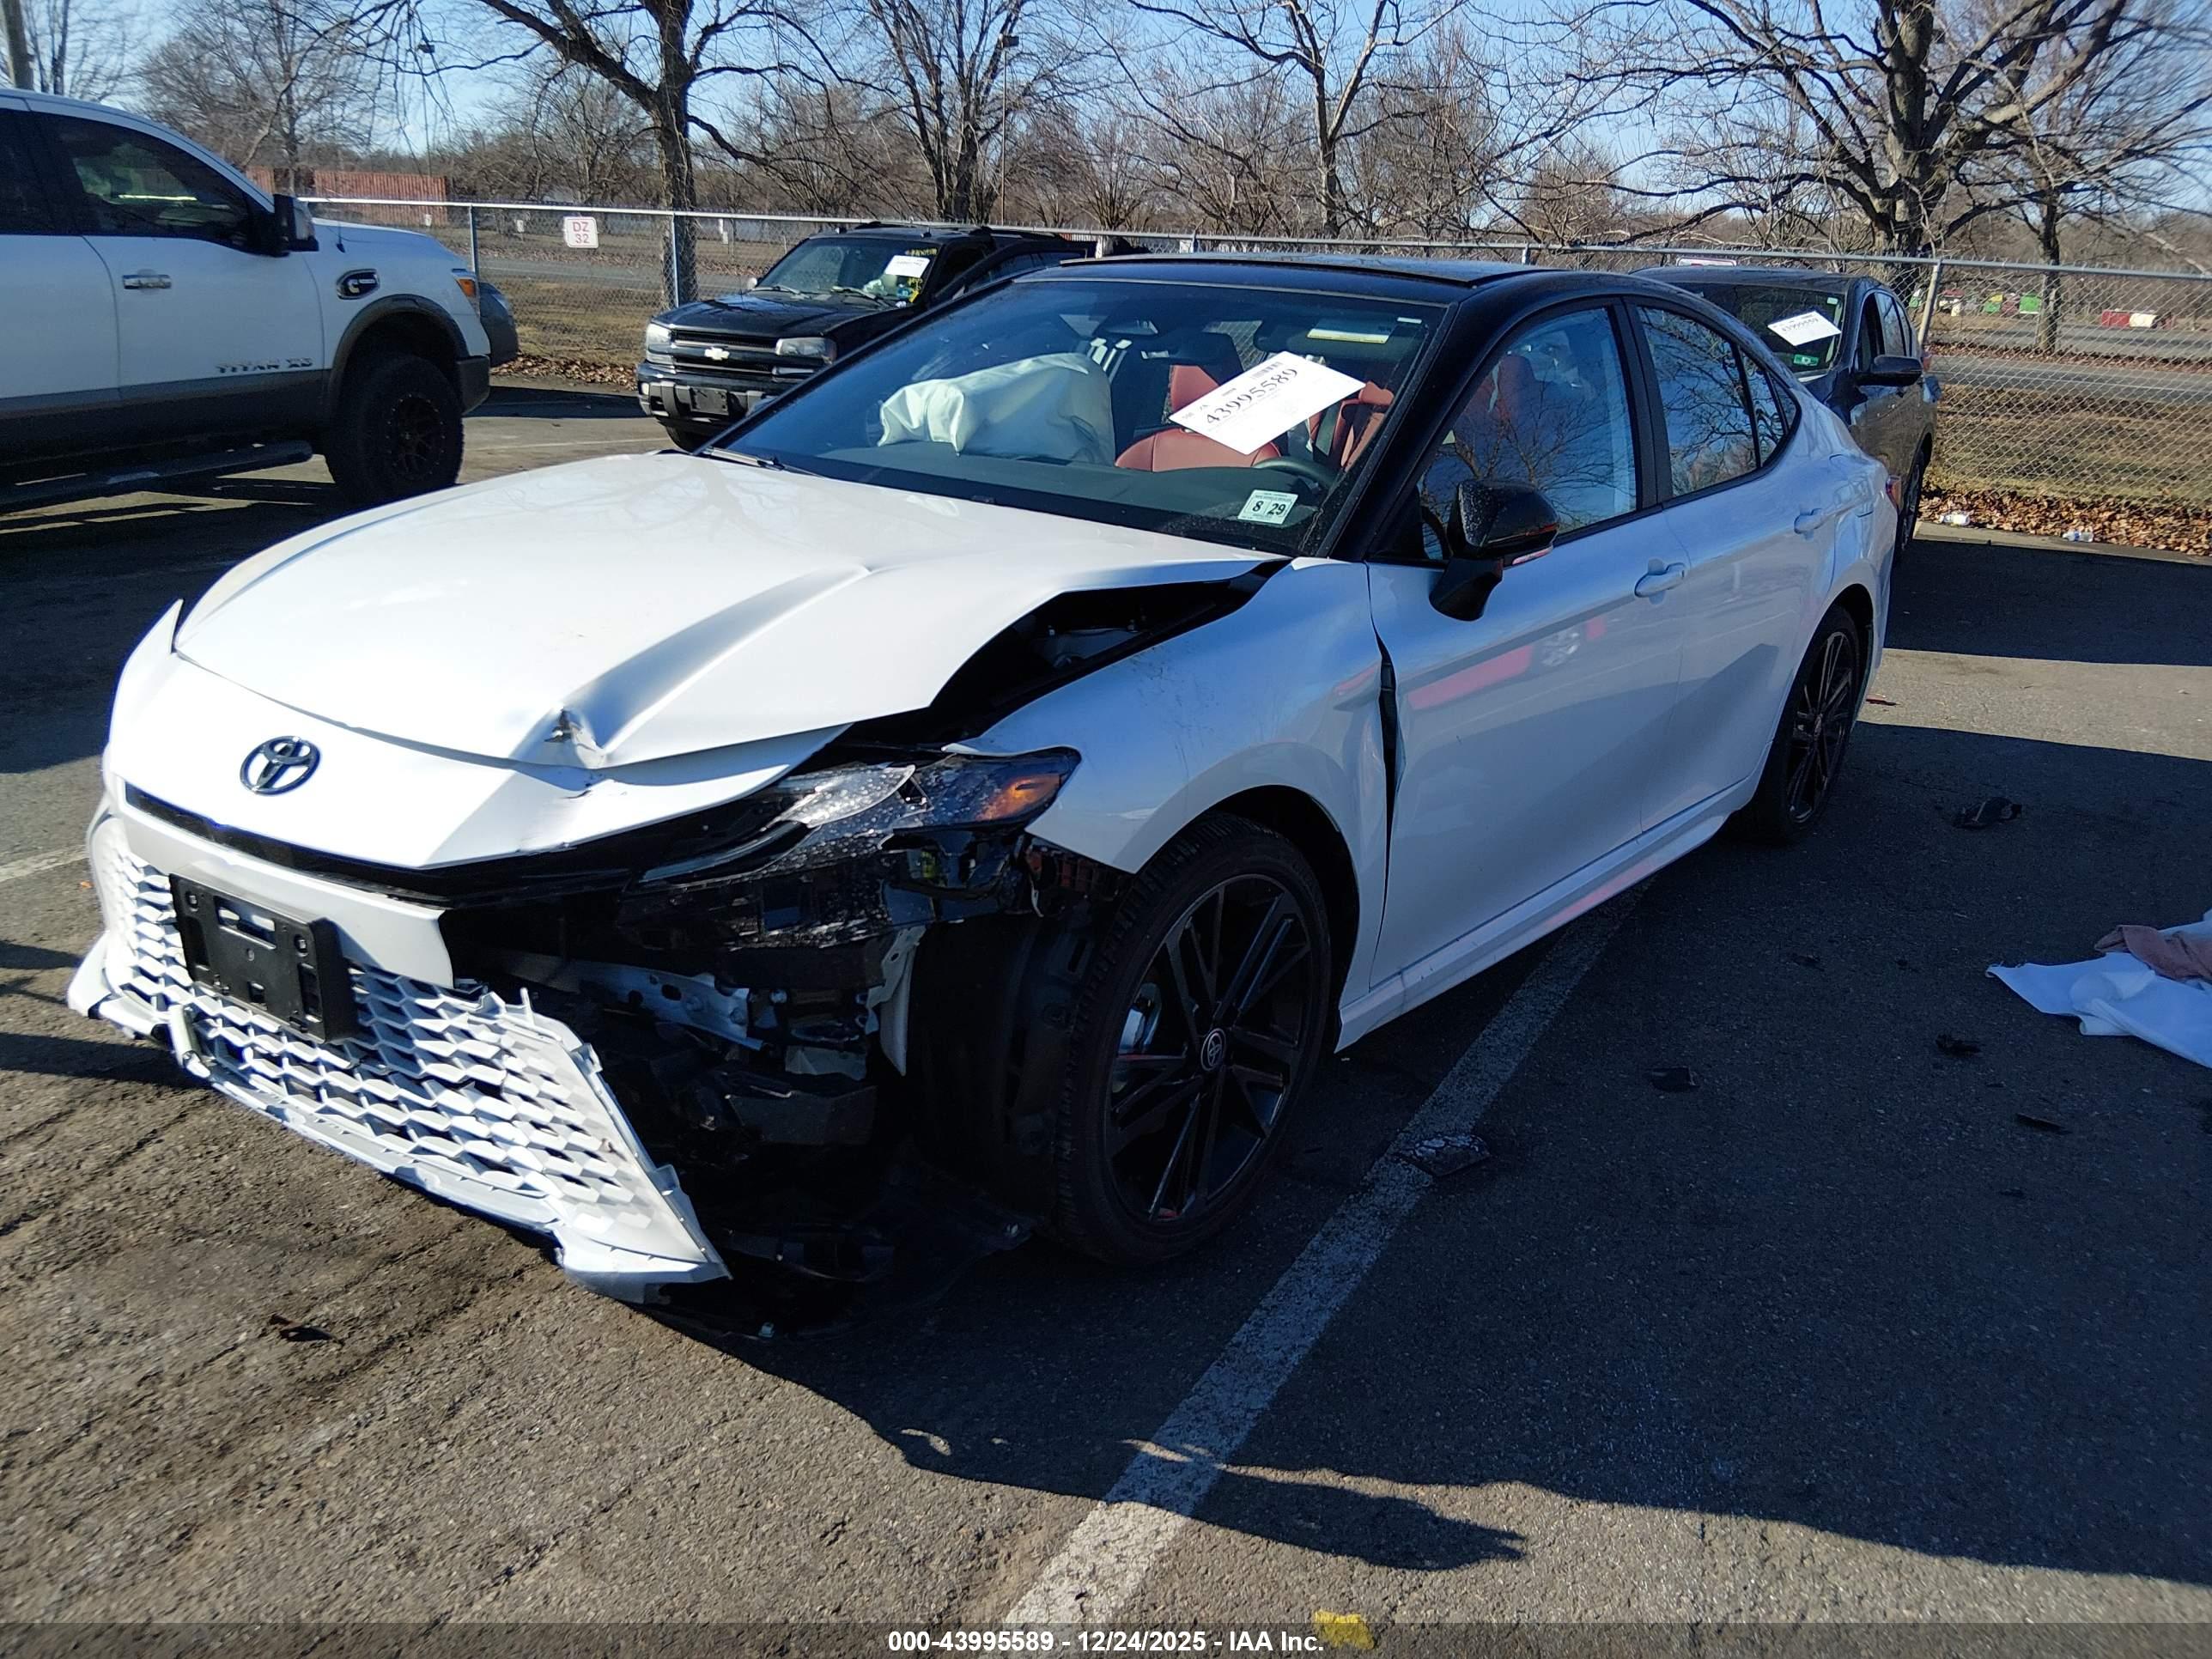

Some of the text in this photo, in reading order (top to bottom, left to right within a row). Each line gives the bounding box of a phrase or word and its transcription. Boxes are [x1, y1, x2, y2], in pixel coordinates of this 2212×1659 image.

[572, 221, 590, 233] DZ
[574, 233, 590, 244] 32
[216, 362, 280, 374] TITAN
[1206, 368, 1298, 424] 43995589
[1252, 500, 1286, 515] 8 29
